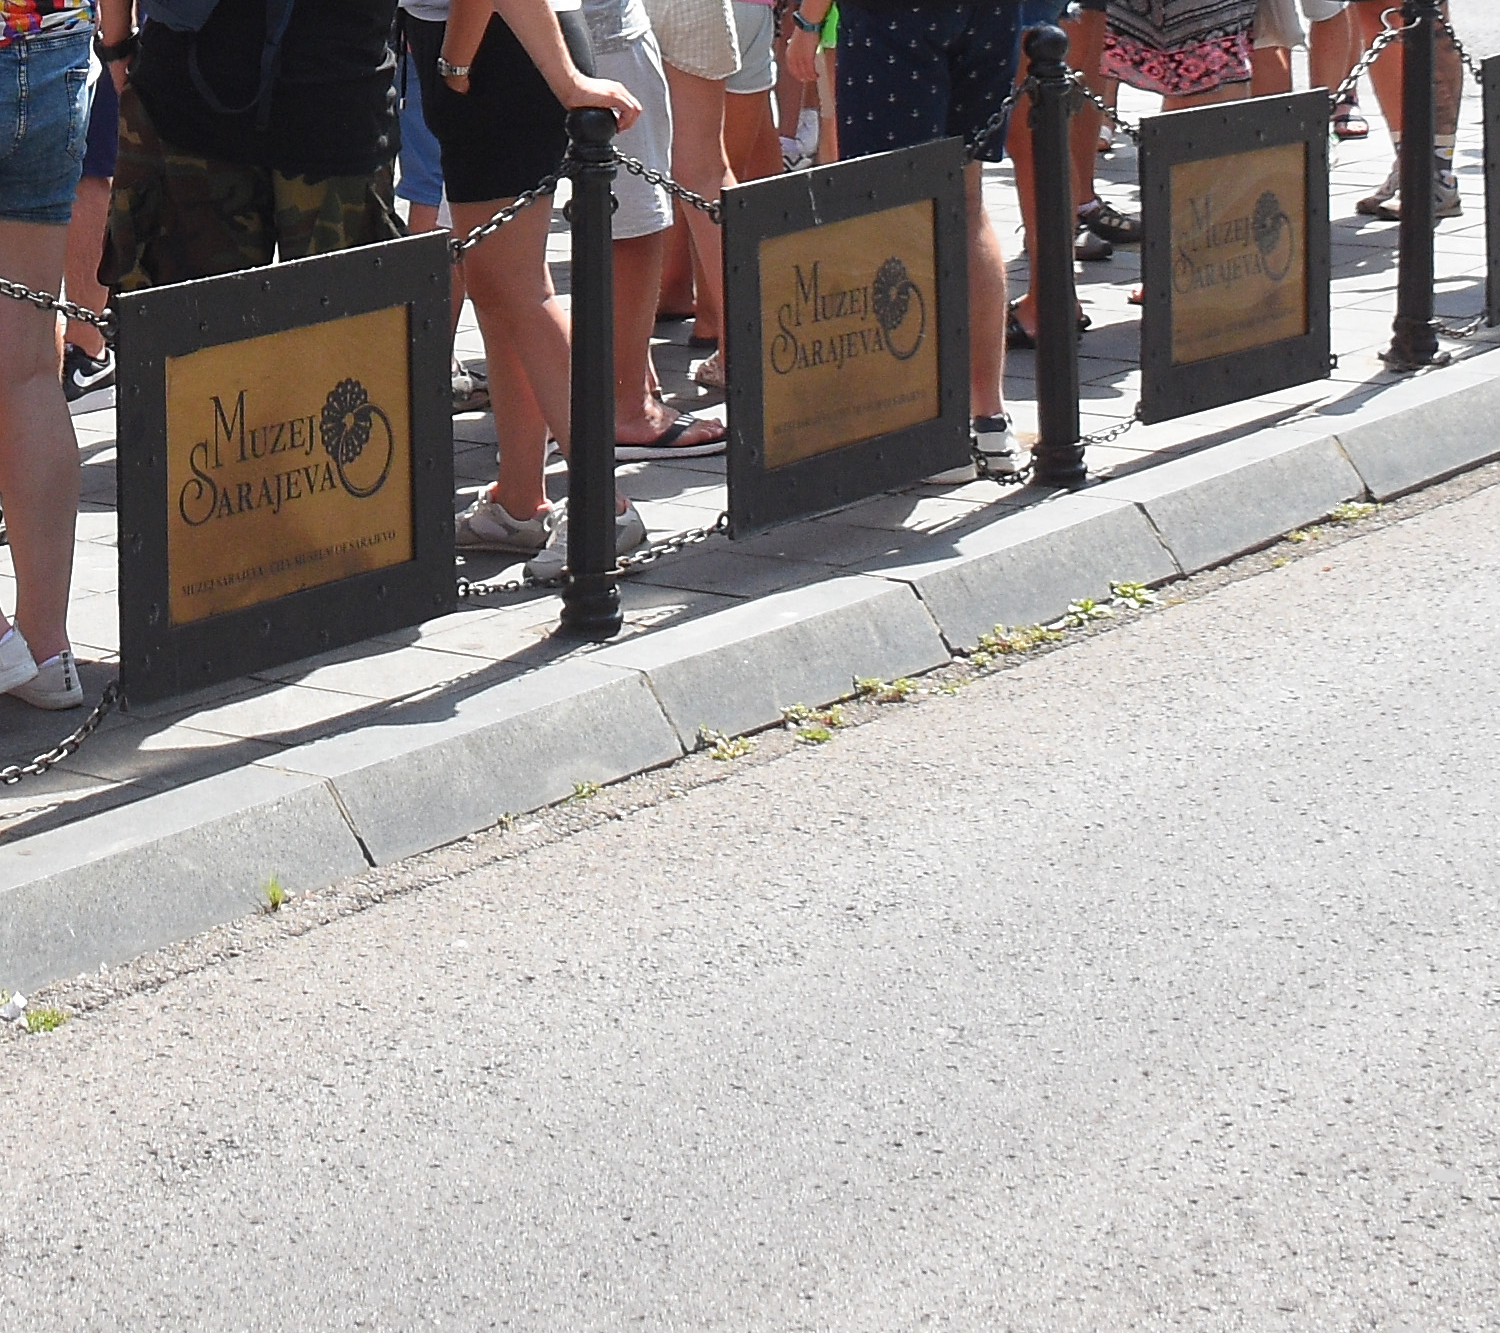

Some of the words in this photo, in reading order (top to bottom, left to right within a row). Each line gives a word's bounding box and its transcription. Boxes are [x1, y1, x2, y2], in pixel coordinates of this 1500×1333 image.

[792, 260, 869, 327] MUZEJ
[770, 303, 885, 376] SARAJEVA
[209, 389, 317, 470] MUZEJ
[178, 439, 340, 528] SARAJEVA
